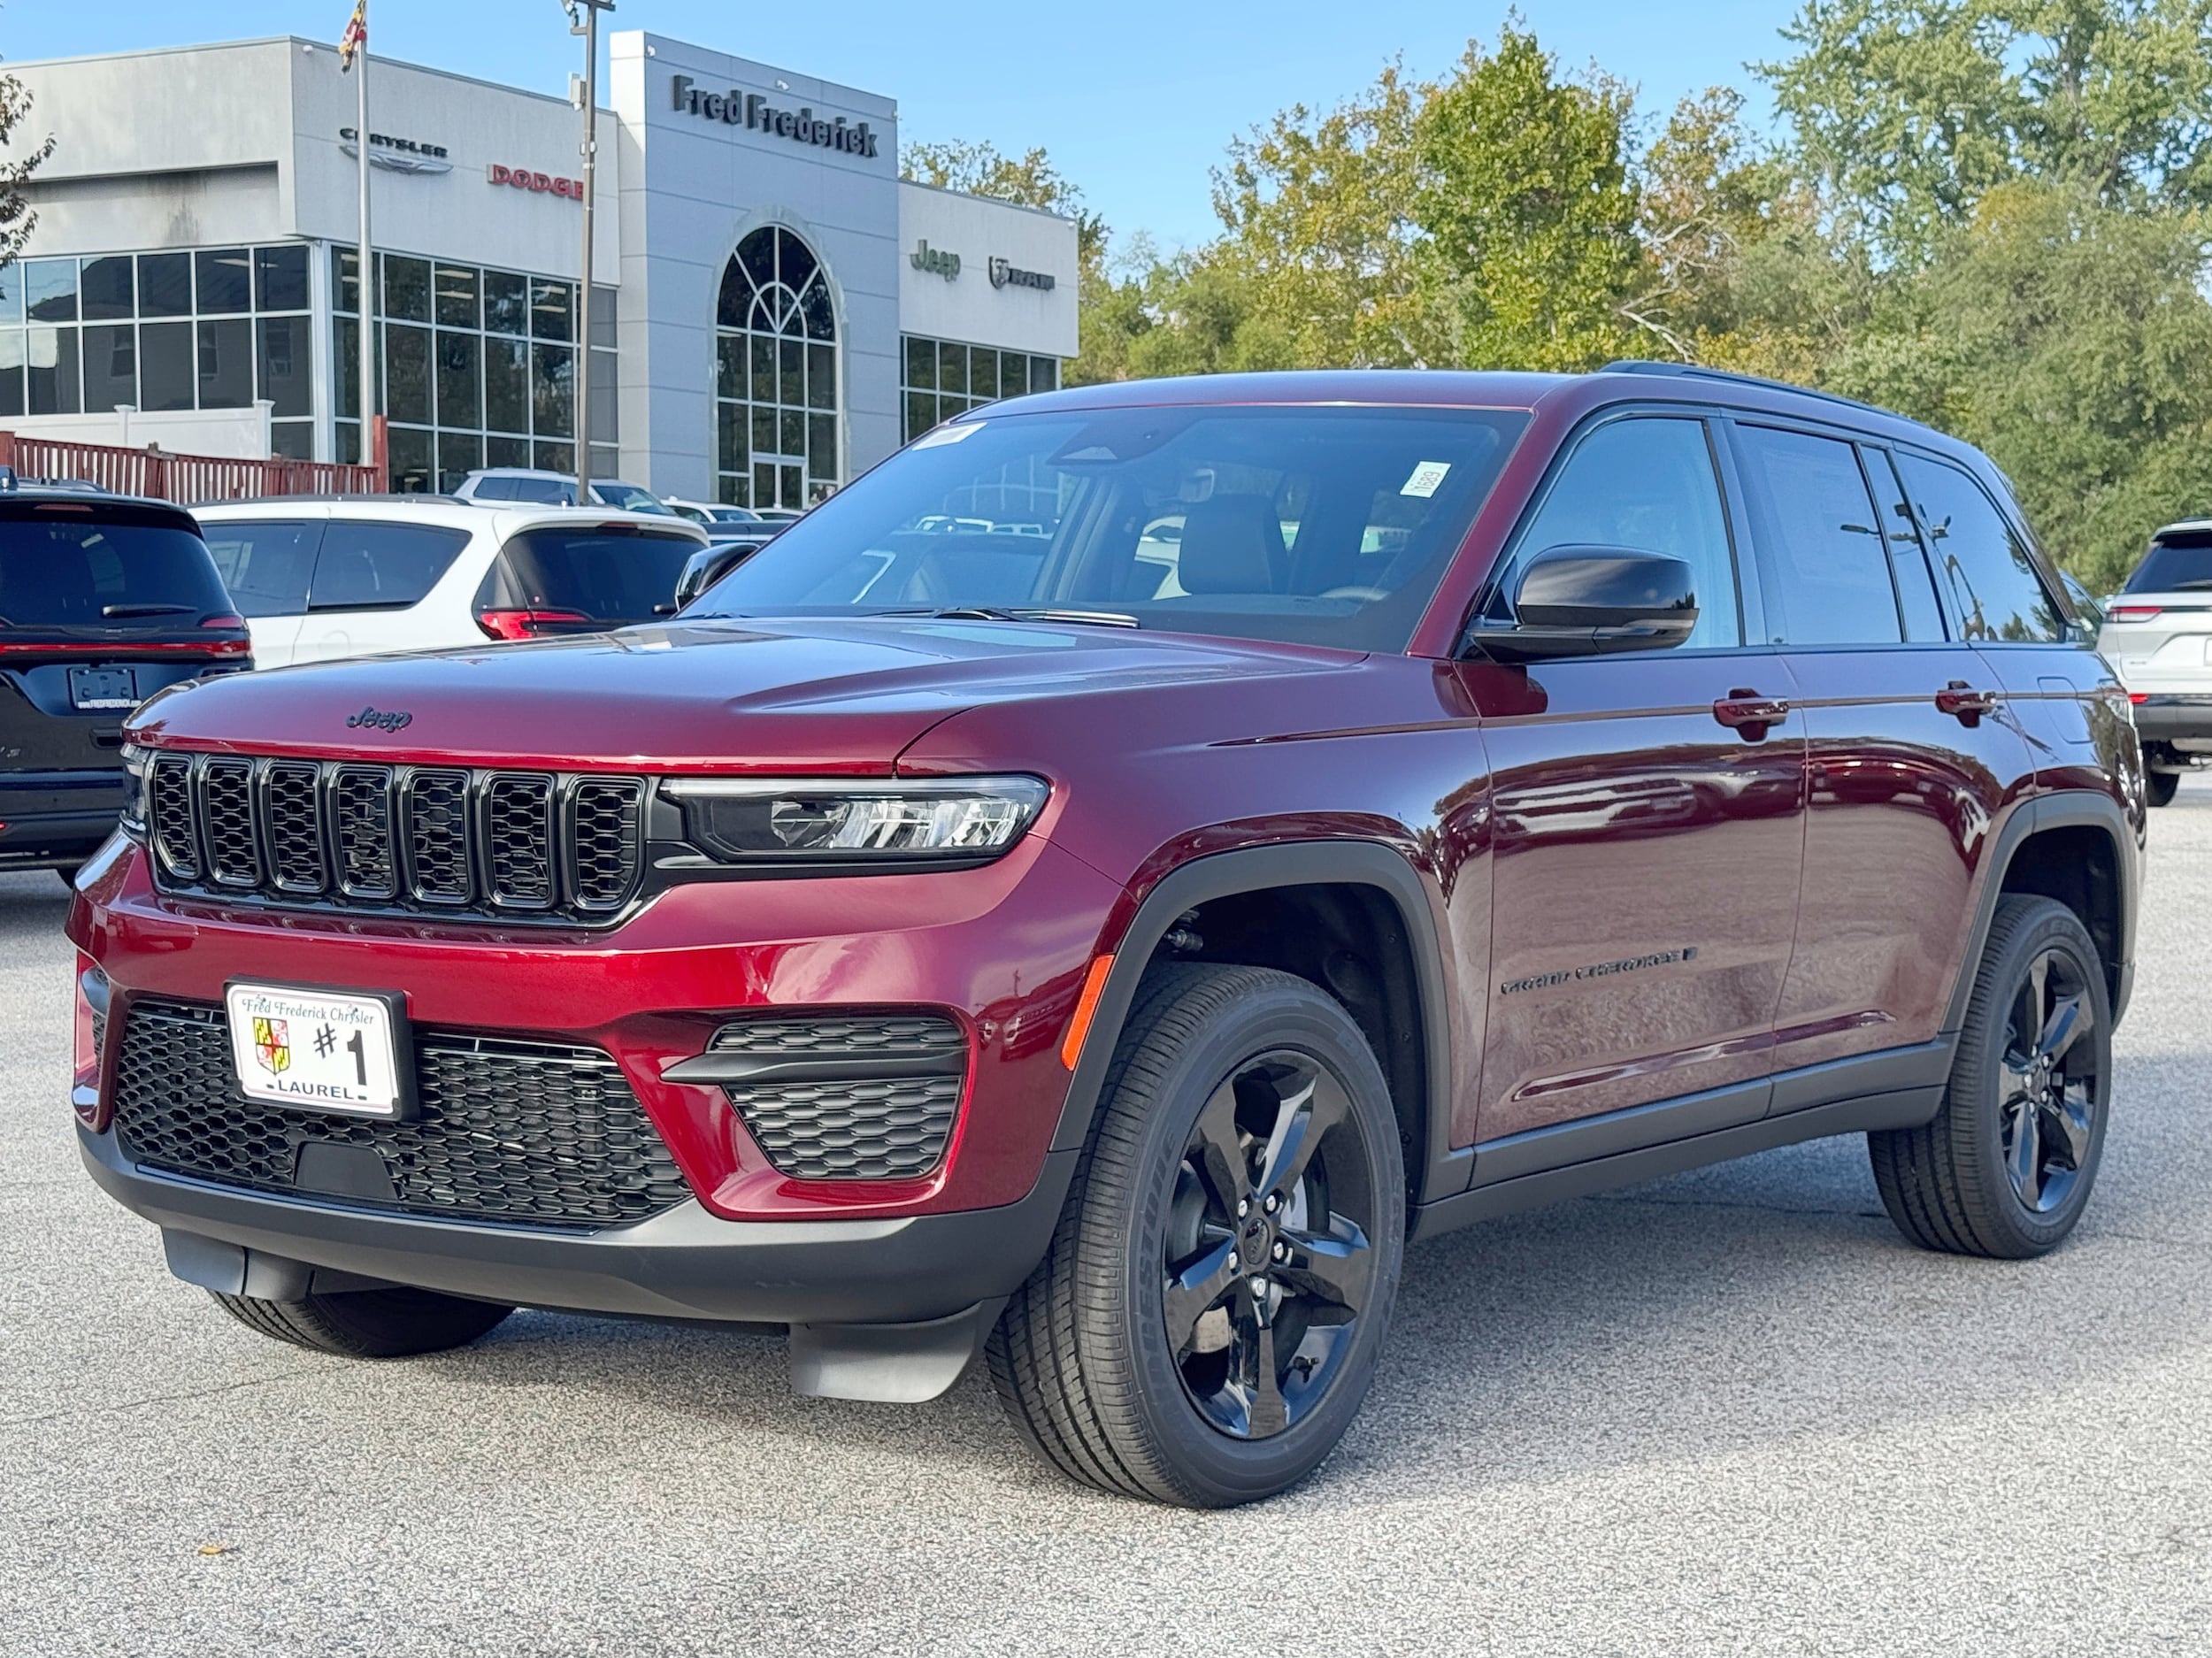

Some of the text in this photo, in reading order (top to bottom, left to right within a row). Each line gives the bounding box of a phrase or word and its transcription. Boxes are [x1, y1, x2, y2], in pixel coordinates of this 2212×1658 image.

[673, 75, 878, 157] Fred Frederick
[910, 239, 961, 282] Jeep
[1008, 268, 1055, 291] RAM
[346, 706, 412, 733] Jeep
[242, 997, 374, 1025] Fred Frederick Chrysler
[278, 1079, 355, 1100] LAUREL
